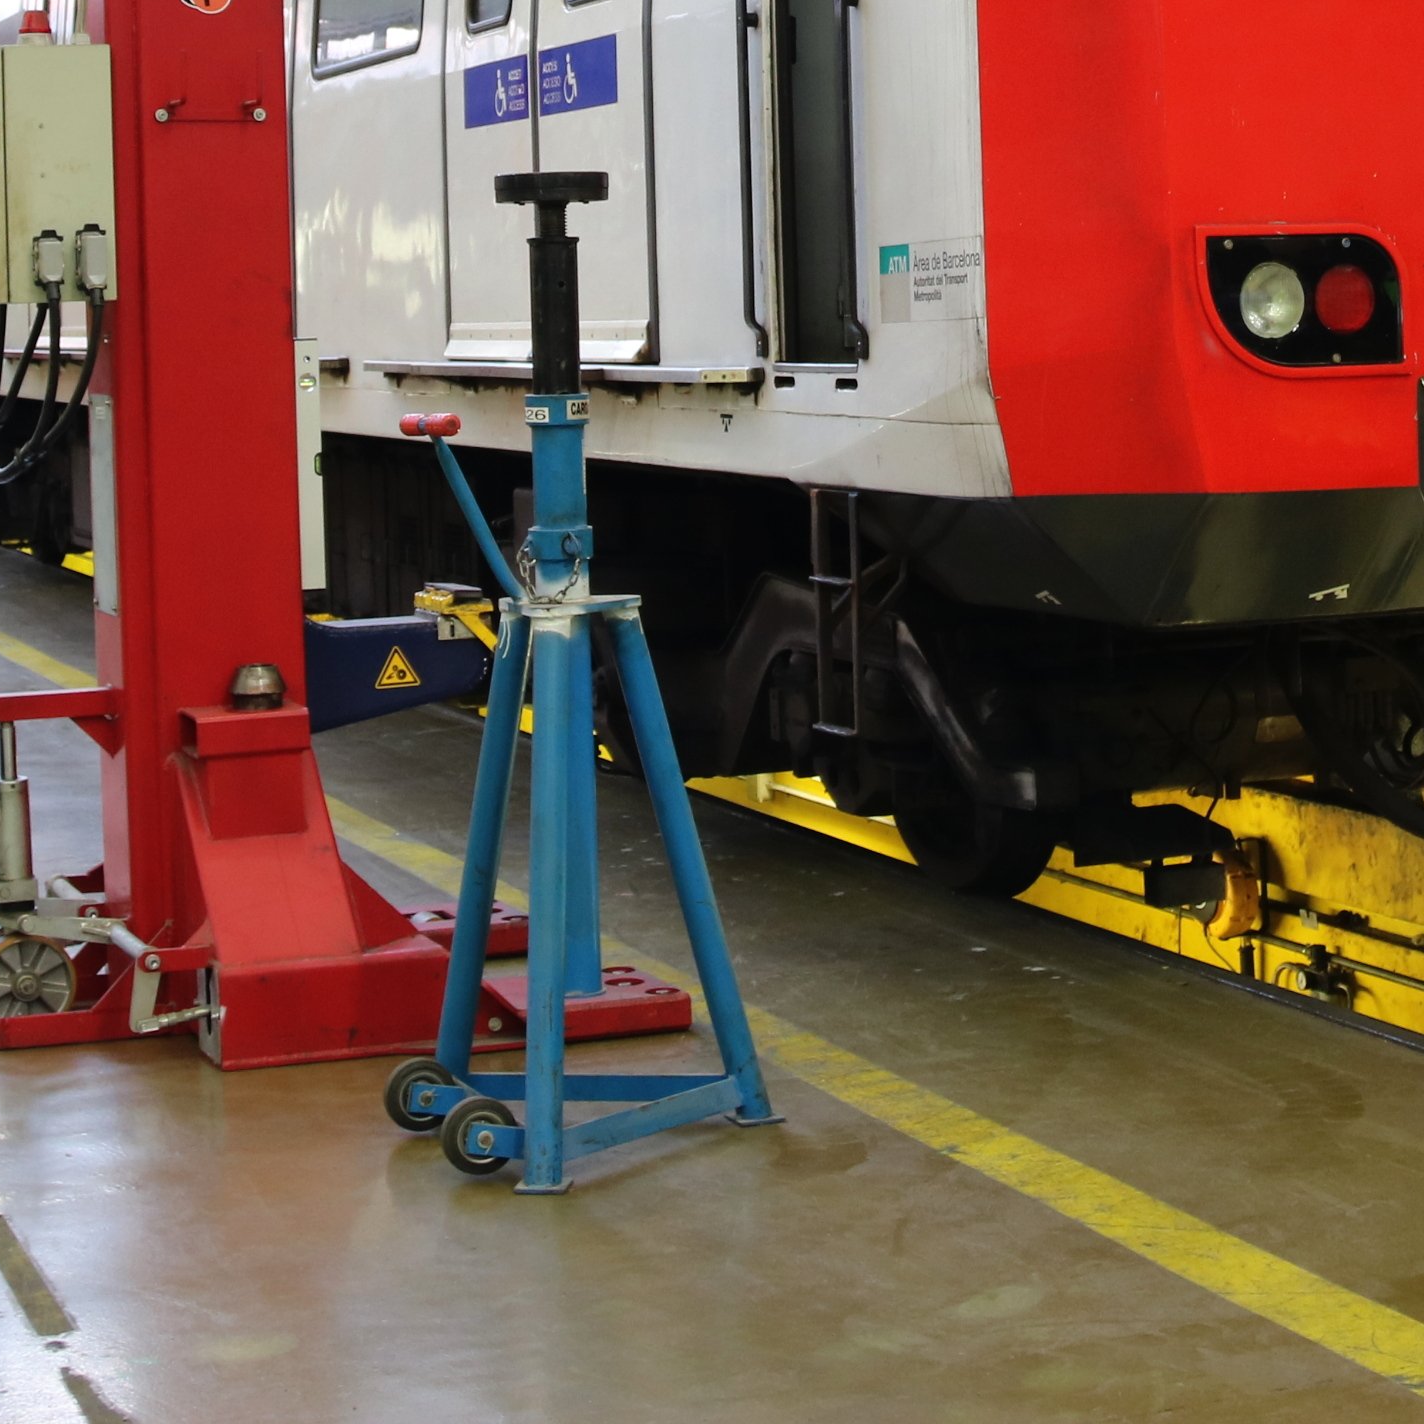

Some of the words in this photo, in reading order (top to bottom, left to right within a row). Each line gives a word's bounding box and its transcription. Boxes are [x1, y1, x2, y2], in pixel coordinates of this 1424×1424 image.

[888, 255, 907, 274] ATM
[913, 250, 930, 272] Àrea
[931, 252, 941, 271] de
[942, 249, 981, 270] Barcelona
[914, 275, 935, 287] Autoritat
[936, 273, 944, 286] del
[944, 273, 968, 286] Transport
